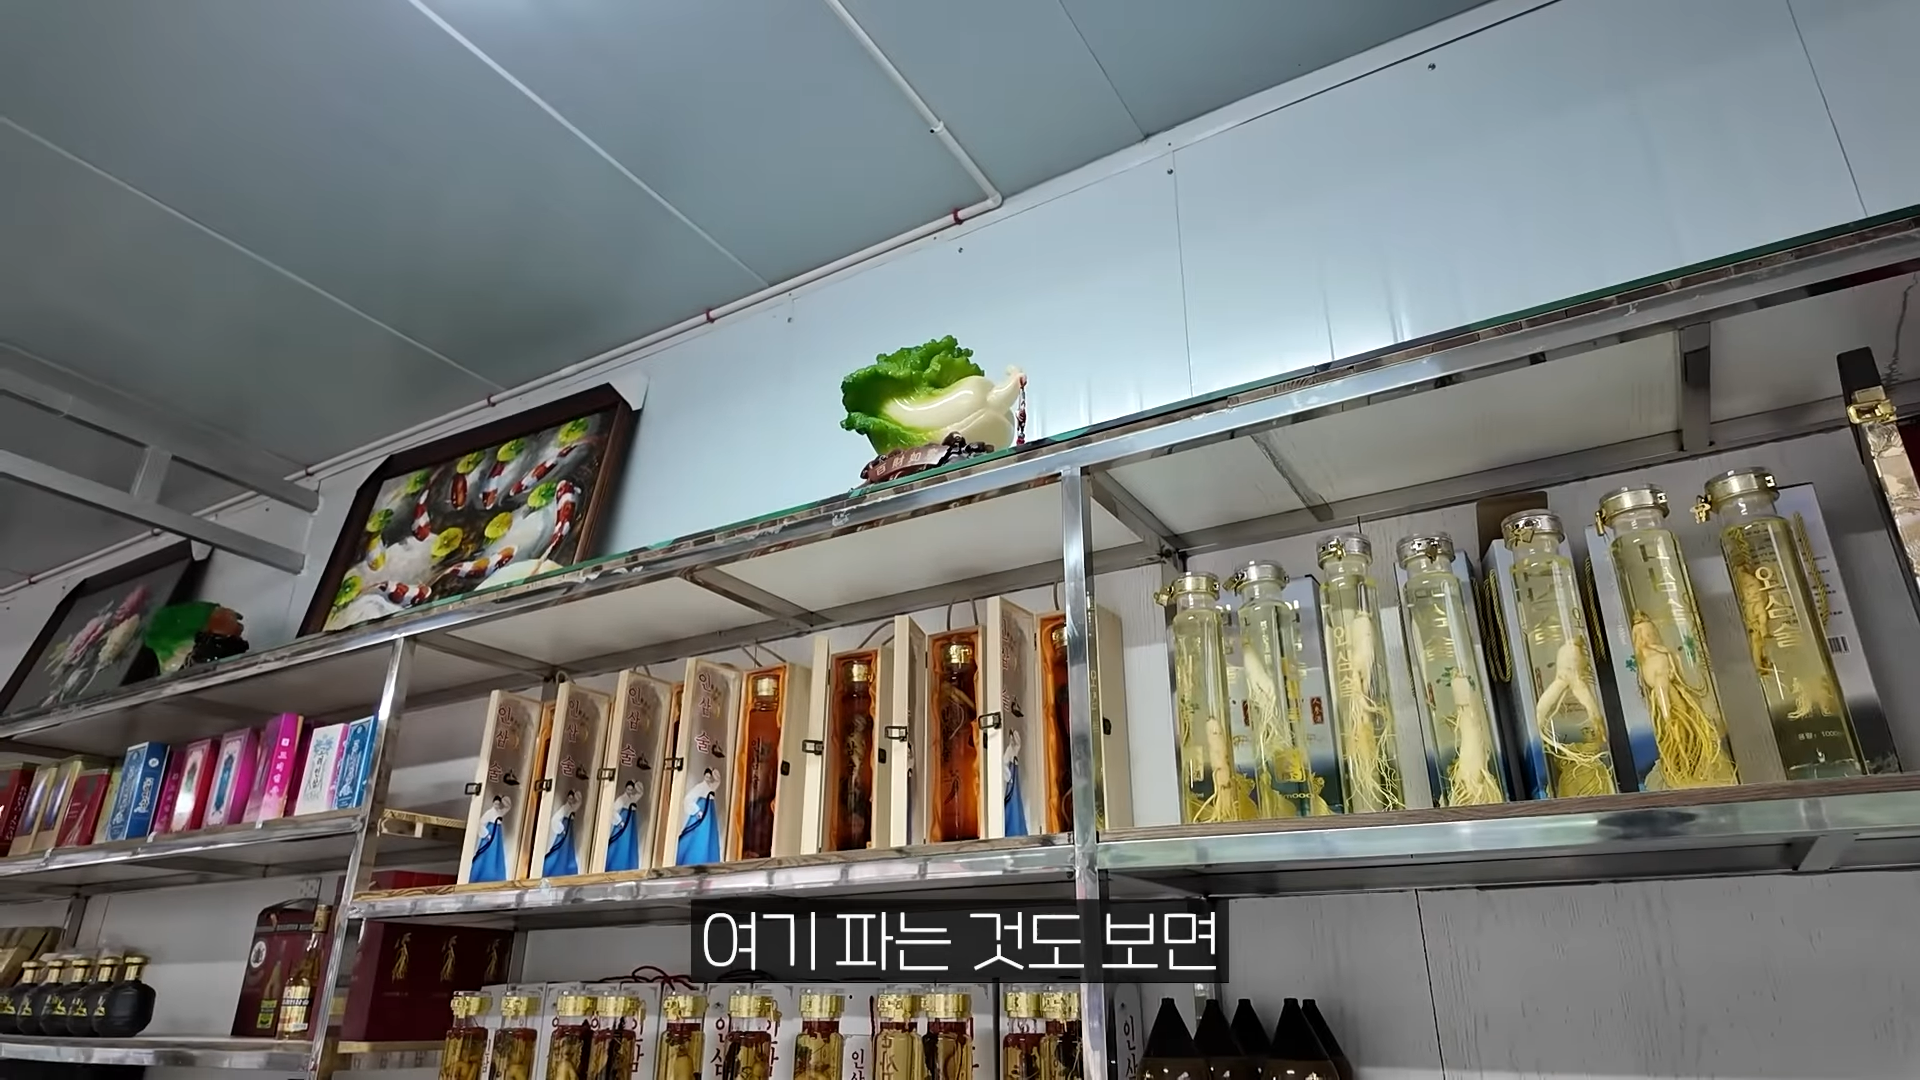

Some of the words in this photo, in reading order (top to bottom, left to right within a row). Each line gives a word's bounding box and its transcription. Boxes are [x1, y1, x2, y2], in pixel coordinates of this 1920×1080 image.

[627, 687, 642, 731] 인삼
[698, 673, 713, 718] 인삼
[496, 706, 512, 749] 인삼
[566, 700, 580, 743] 인삼
[620, 744, 636, 767] 술
[694, 732, 711, 754] 술
[488, 761, 503, 783] 술
[560, 755, 575, 778] 술
